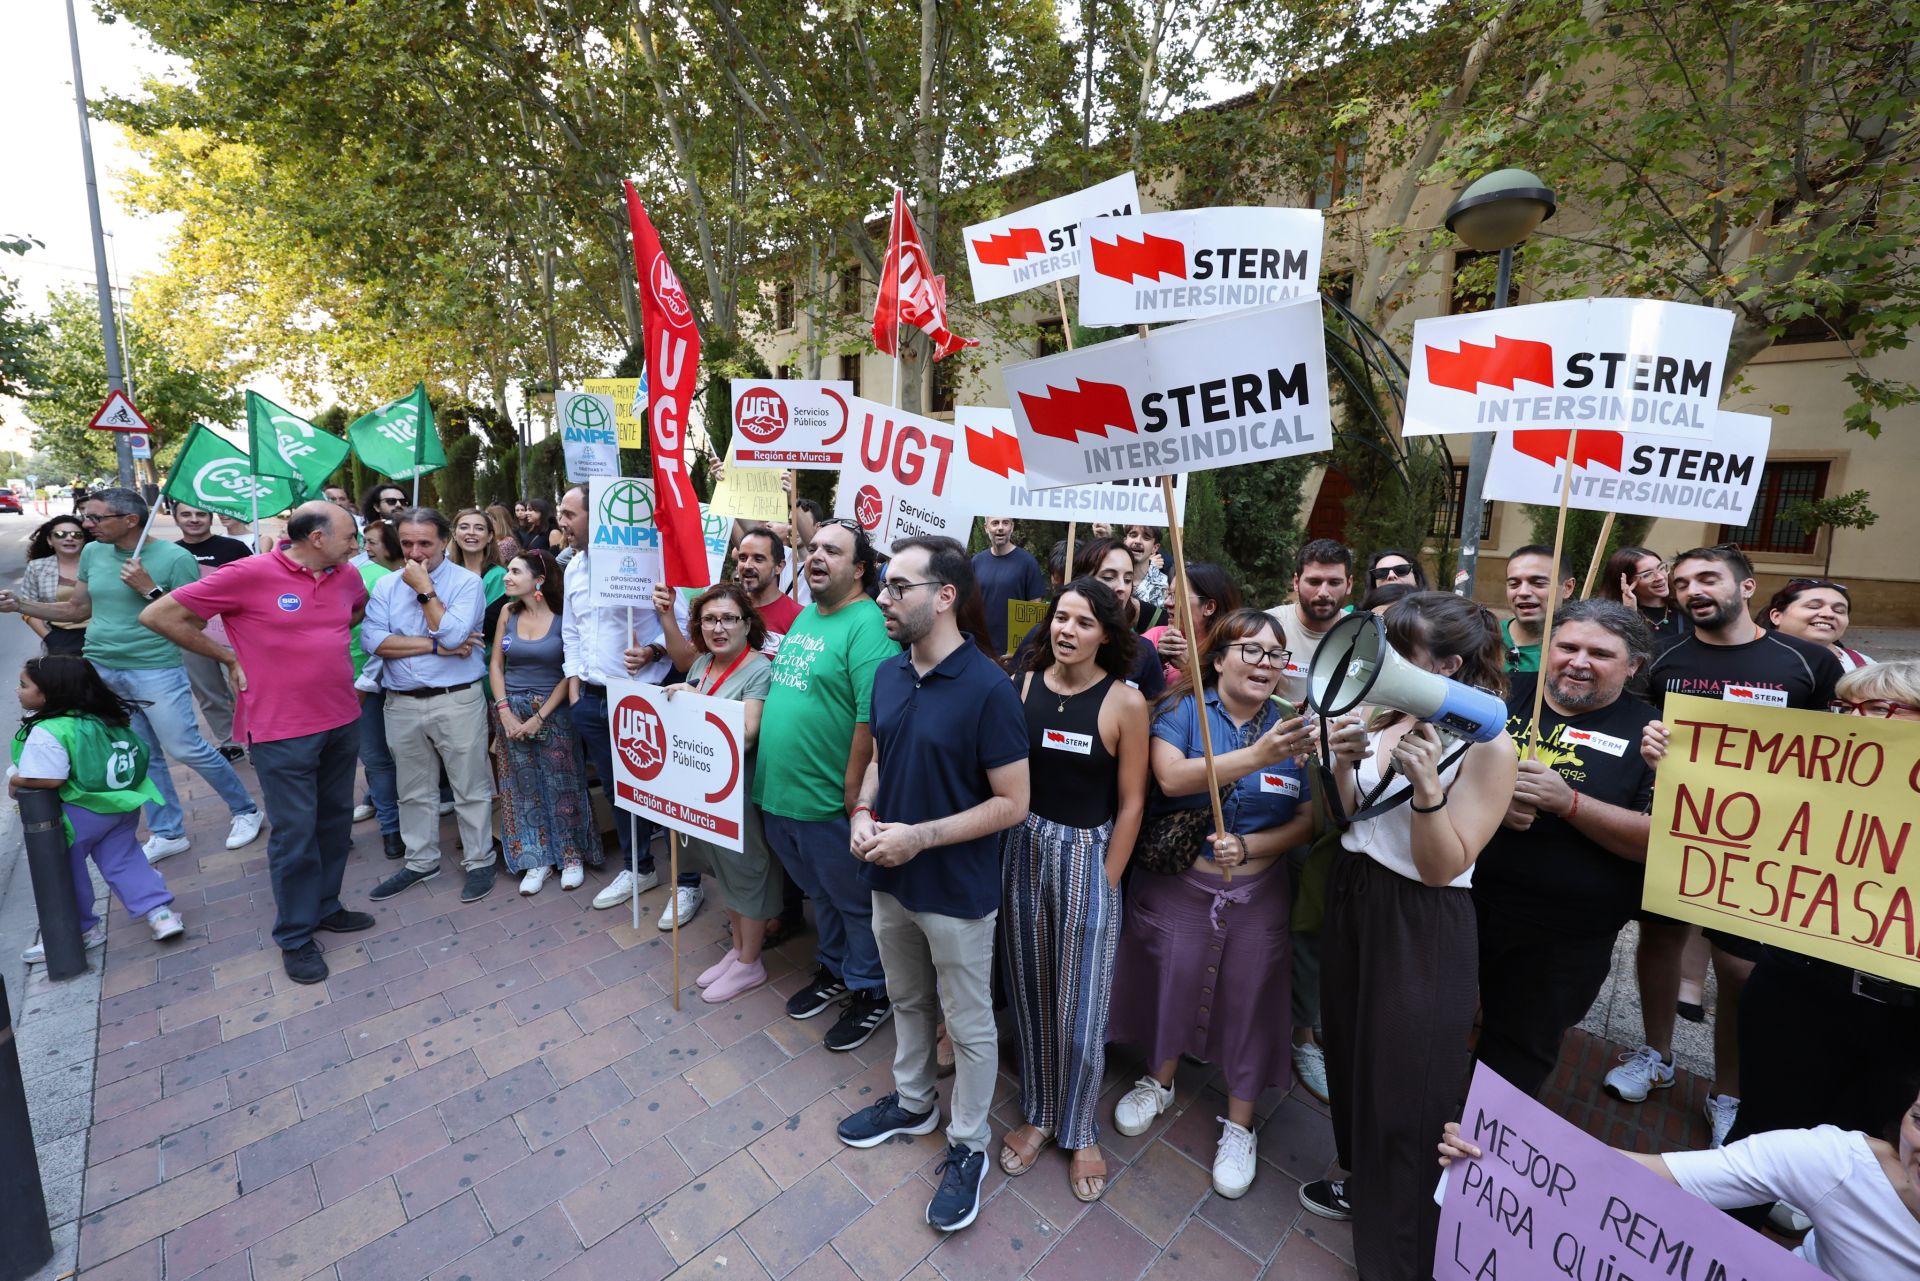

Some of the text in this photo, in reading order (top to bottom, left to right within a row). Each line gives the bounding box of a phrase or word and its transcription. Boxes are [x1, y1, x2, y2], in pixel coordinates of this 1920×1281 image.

[1013, 250, 1080, 284] INTERSI
[1192, 248, 1308, 280] STERM
[1563, 352, 1711, 398] STERM
[741, 397, 780, 419] UGT
[793, 407, 829, 416] Servicios
[1141, 362, 1310, 433] STERM
[1477, 395, 1705, 429] INTERSINDICAL
[654, 329, 688, 508] UGT
[793, 417, 827, 427] Públicos
[564, 426, 616, 445] ANPE
[1084, 415, 1314, 474] INTERSINDICAL
[754, 450, 831, 462] Región de Murcia
[860, 413, 953, 497] UGT
[1628, 445, 1754, 486] STERM
[1010, 486, 1168, 513] INTERSINDICA
[1553, 474, 1743, 512] INTERSINDICAL
[896, 517, 931, 537] Públic
[899, 499, 946, 529] Servicios
[610, 576, 652, 584] OPOSICIONES
[610, 584, 640, 592] OBJETIVAS
[1754, 693, 1784, 703] STERM
[618, 706, 659, 749] UGT
[1065, 738, 1089, 748] STERM
[1591, 736, 1623, 751] STERM
[672, 734, 714, 757] Servicios
[673, 750, 711, 773] Públicos
[633, 787, 716, 830] Región de Murcia
[1671, 783, 1912, 875] NO A UN
[1678, 845, 1920, 958] DESFASA
[1474, 1108, 1577, 1206] MEJOR
[1462, 1161, 1534, 1249] PARA
[1454, 1221, 1497, 1281] LA
